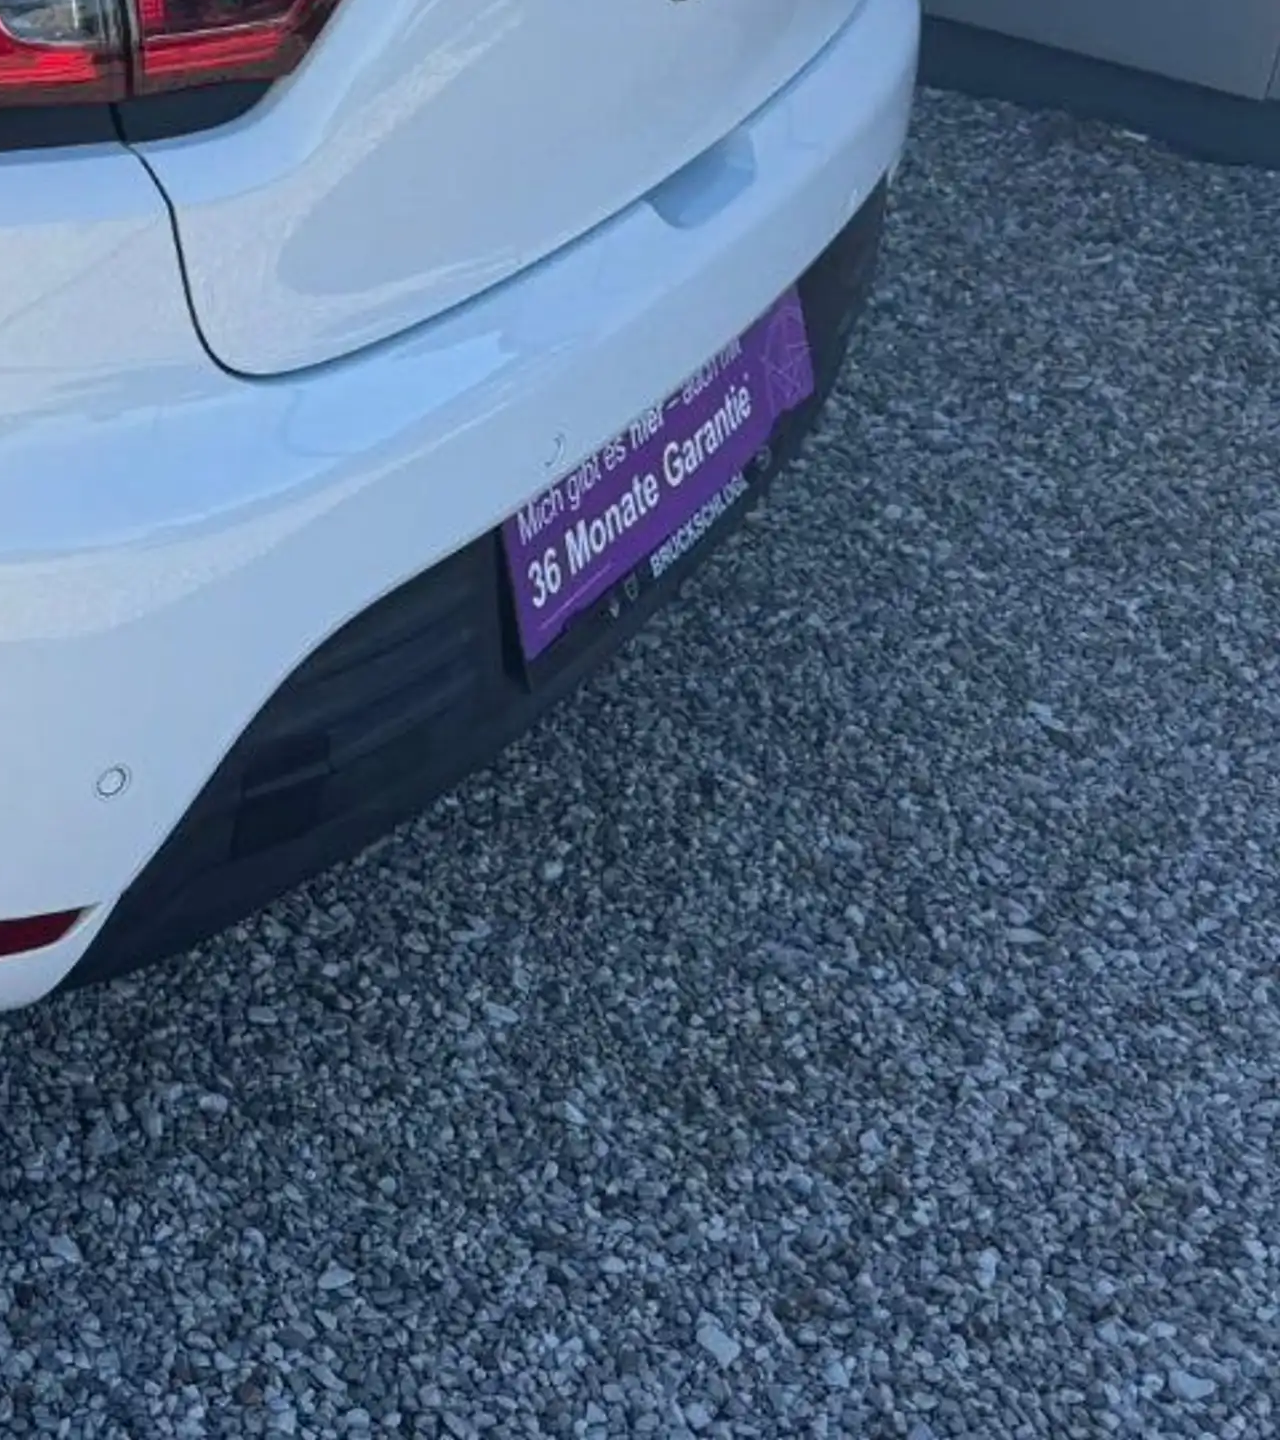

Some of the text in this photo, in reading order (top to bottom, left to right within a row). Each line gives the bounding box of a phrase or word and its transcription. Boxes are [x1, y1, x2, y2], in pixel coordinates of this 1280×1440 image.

[603, 437, 627, 471] es
[528, 547, 561, 608] 36
[564, 473, 660, 576] Monate
